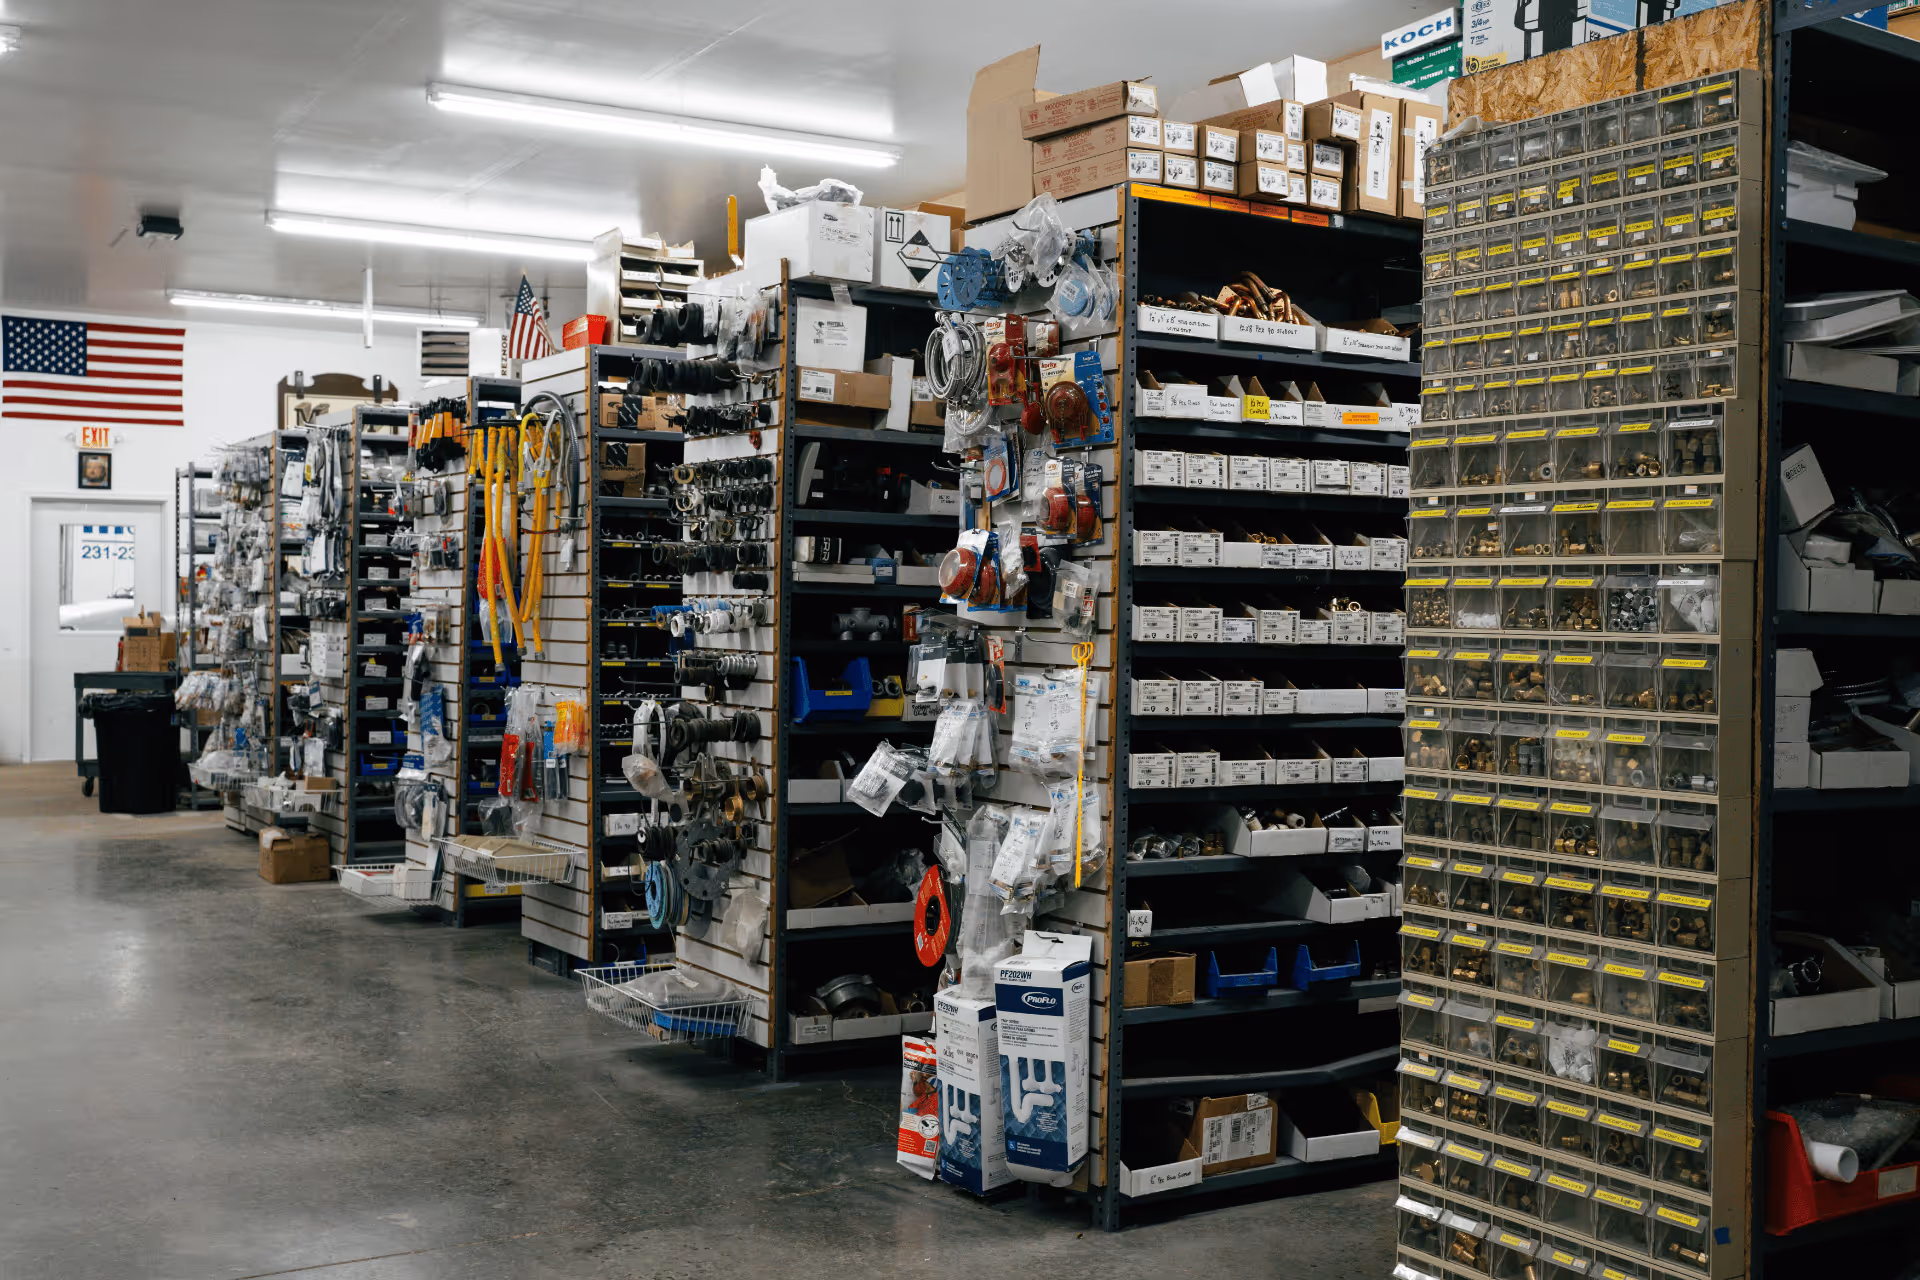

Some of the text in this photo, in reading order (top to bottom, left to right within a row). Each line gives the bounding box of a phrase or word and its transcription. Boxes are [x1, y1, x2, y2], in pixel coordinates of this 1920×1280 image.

[1384, 16, 1452, 51] KOCH
[1420, 70, 1443, 81] FILTERBUY
[1044, 99, 1073, 111] WOODFORD
[986, 320, 1002, 329] korky
[1041, 361, 1057, 369] korky
[82, 427, 110, 447] EXIT
[1000, 969, 1032, 980] PF202WH
[1026, 995, 1057, 1005] PROFLO
[937, 1001, 959, 1015] PF202WH
